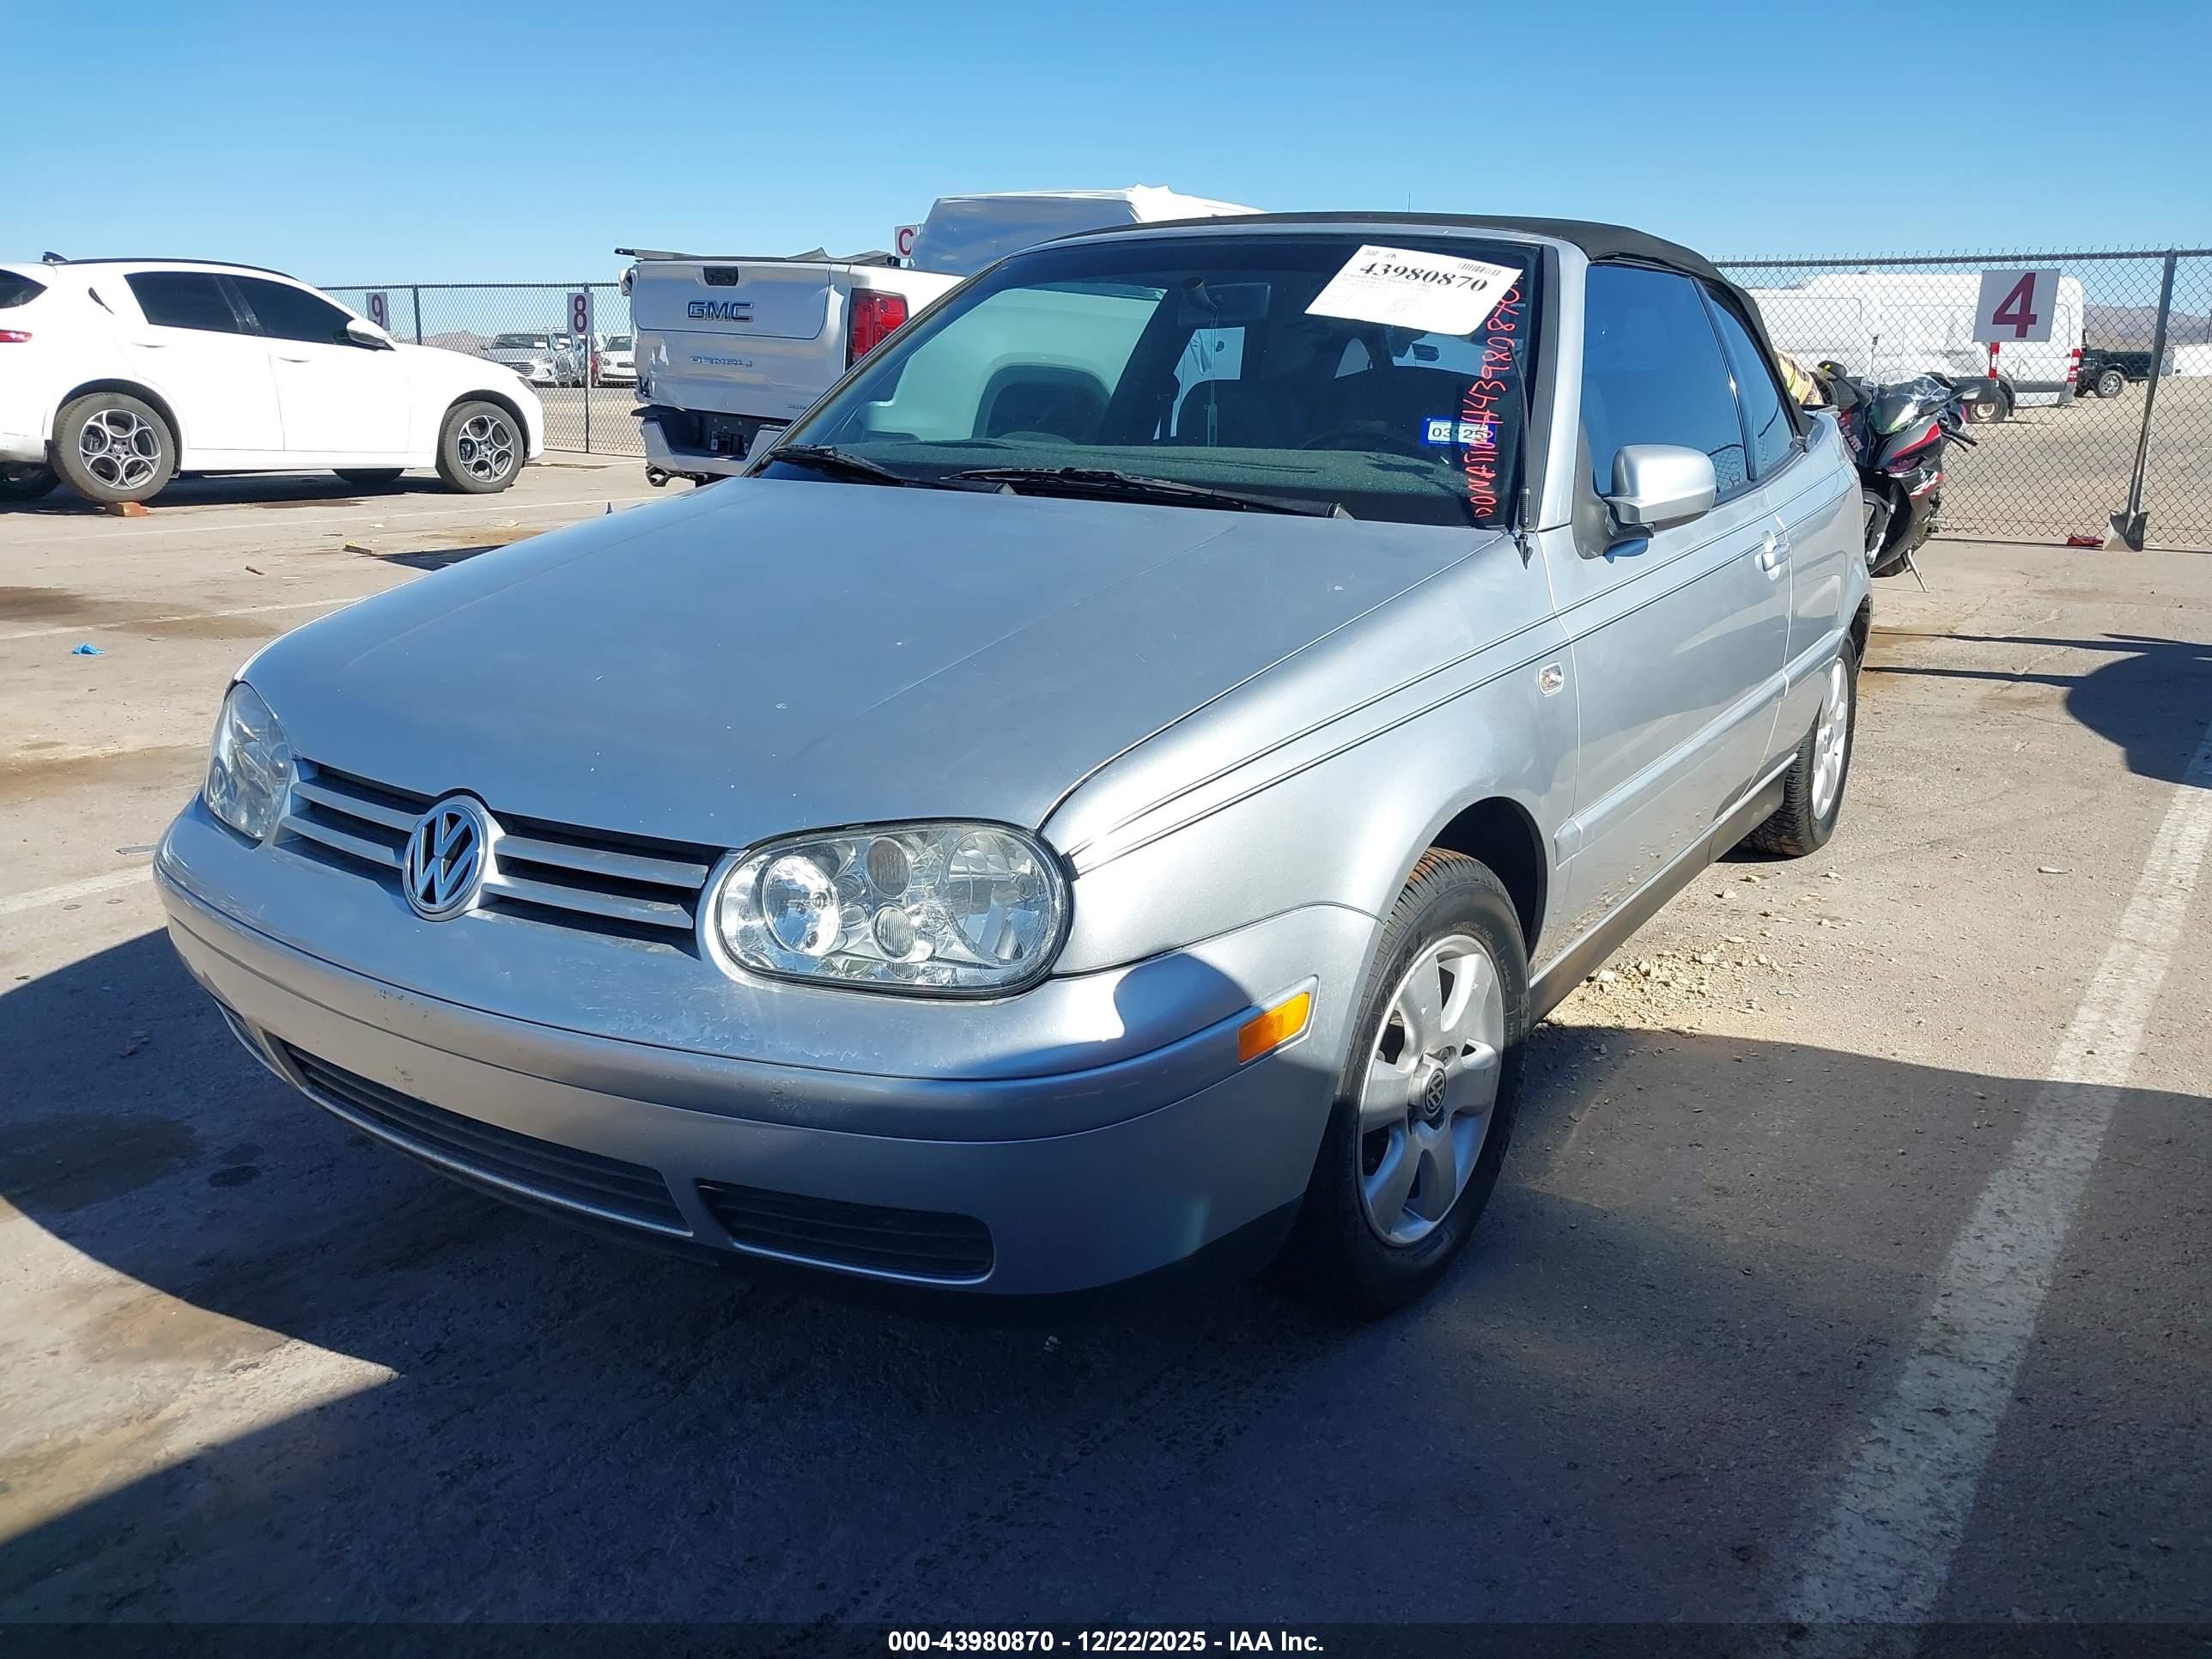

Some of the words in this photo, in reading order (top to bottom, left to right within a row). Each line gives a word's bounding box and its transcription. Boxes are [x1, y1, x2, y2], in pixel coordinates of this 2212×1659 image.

[898, 228, 914, 256] C
[1359, 262, 1488, 292] 43980870
[371, 294, 384, 326] 9
[573, 295, 587, 333] 8
[687, 300, 755, 323] GMC
[1991, 272, 2038, 338] 4
[408, 805, 480, 909] VW
